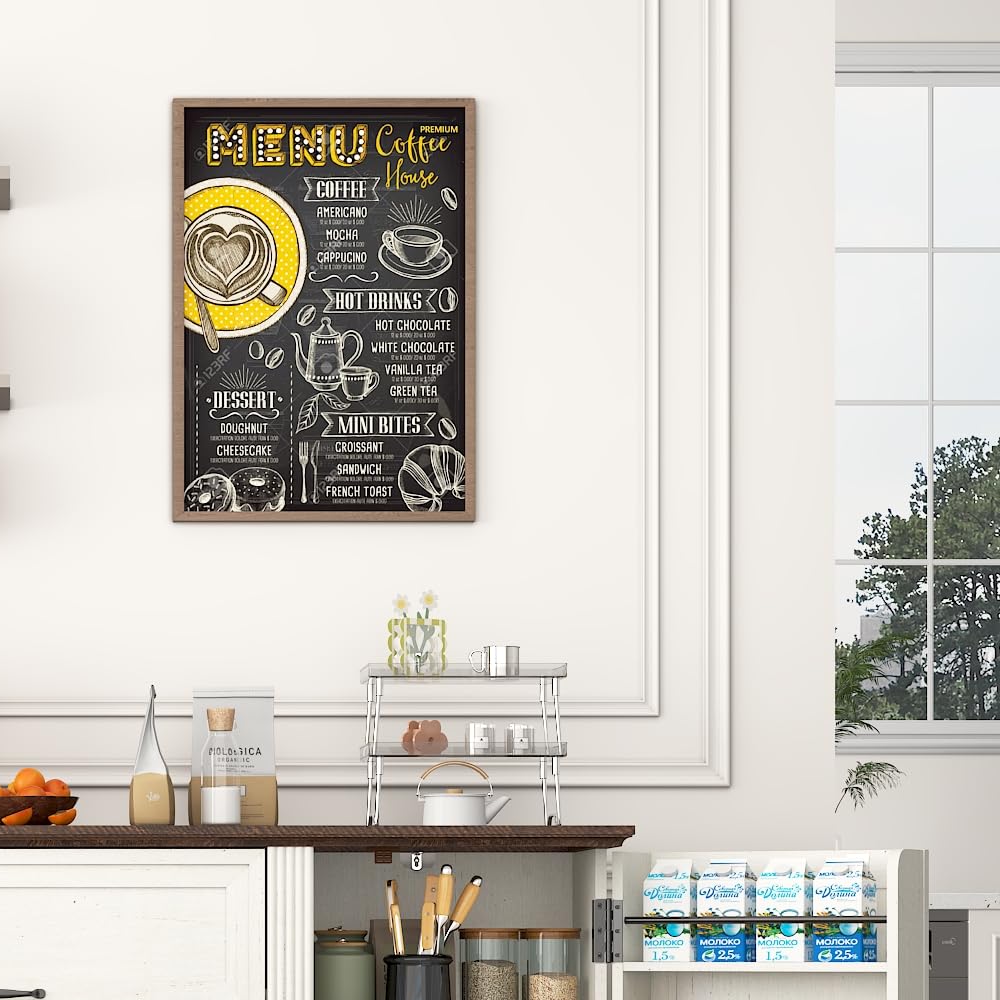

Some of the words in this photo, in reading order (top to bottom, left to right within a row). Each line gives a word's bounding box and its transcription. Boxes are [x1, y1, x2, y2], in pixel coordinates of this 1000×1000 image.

[420, 125, 459, 134] PREMIUM
[206, 122, 368, 167] MENU
[375, 123, 452, 164] Coffee
[385, 157, 439, 190] House
[316, 180, 367, 199] COFFEE
[316, 206, 368, 218] AMERICANO
[325, 229, 359, 241] MOCHA
[317, 252, 367, 263] CAPPUCINO
[335, 292, 364, 310] HOT
[368, 292, 422, 310] DRINKS
[375, 319, 394, 331] HOT
[396, 319, 451, 331] CHOCOLATE
[371, 341, 398, 353] WHITE
[400, 341, 455, 353] CHOCOLATE
[384, 364, 423, 375] VANILLA
[425, 364, 443, 375] TEA
[389, 385, 418, 397] GREEN
[420, 385, 438, 397] TEA
[213, 391, 277, 409] DESSERT
[220, 422, 268, 434] DOUGHNUT
[338, 416, 374, 434] MINI
[378, 416, 421, 434] BITES
[216, 445, 272, 456] CHEESECAKE
[335, 441, 384, 453] CROISSANT
[337, 463, 382, 475] SANDWICH
[325, 485, 361, 497] FRENCH
[363, 485, 393, 497] TOAST
[699, 938, 741, 946] МОЛОКО
[815, 938, 858, 946] МОЛОКО
